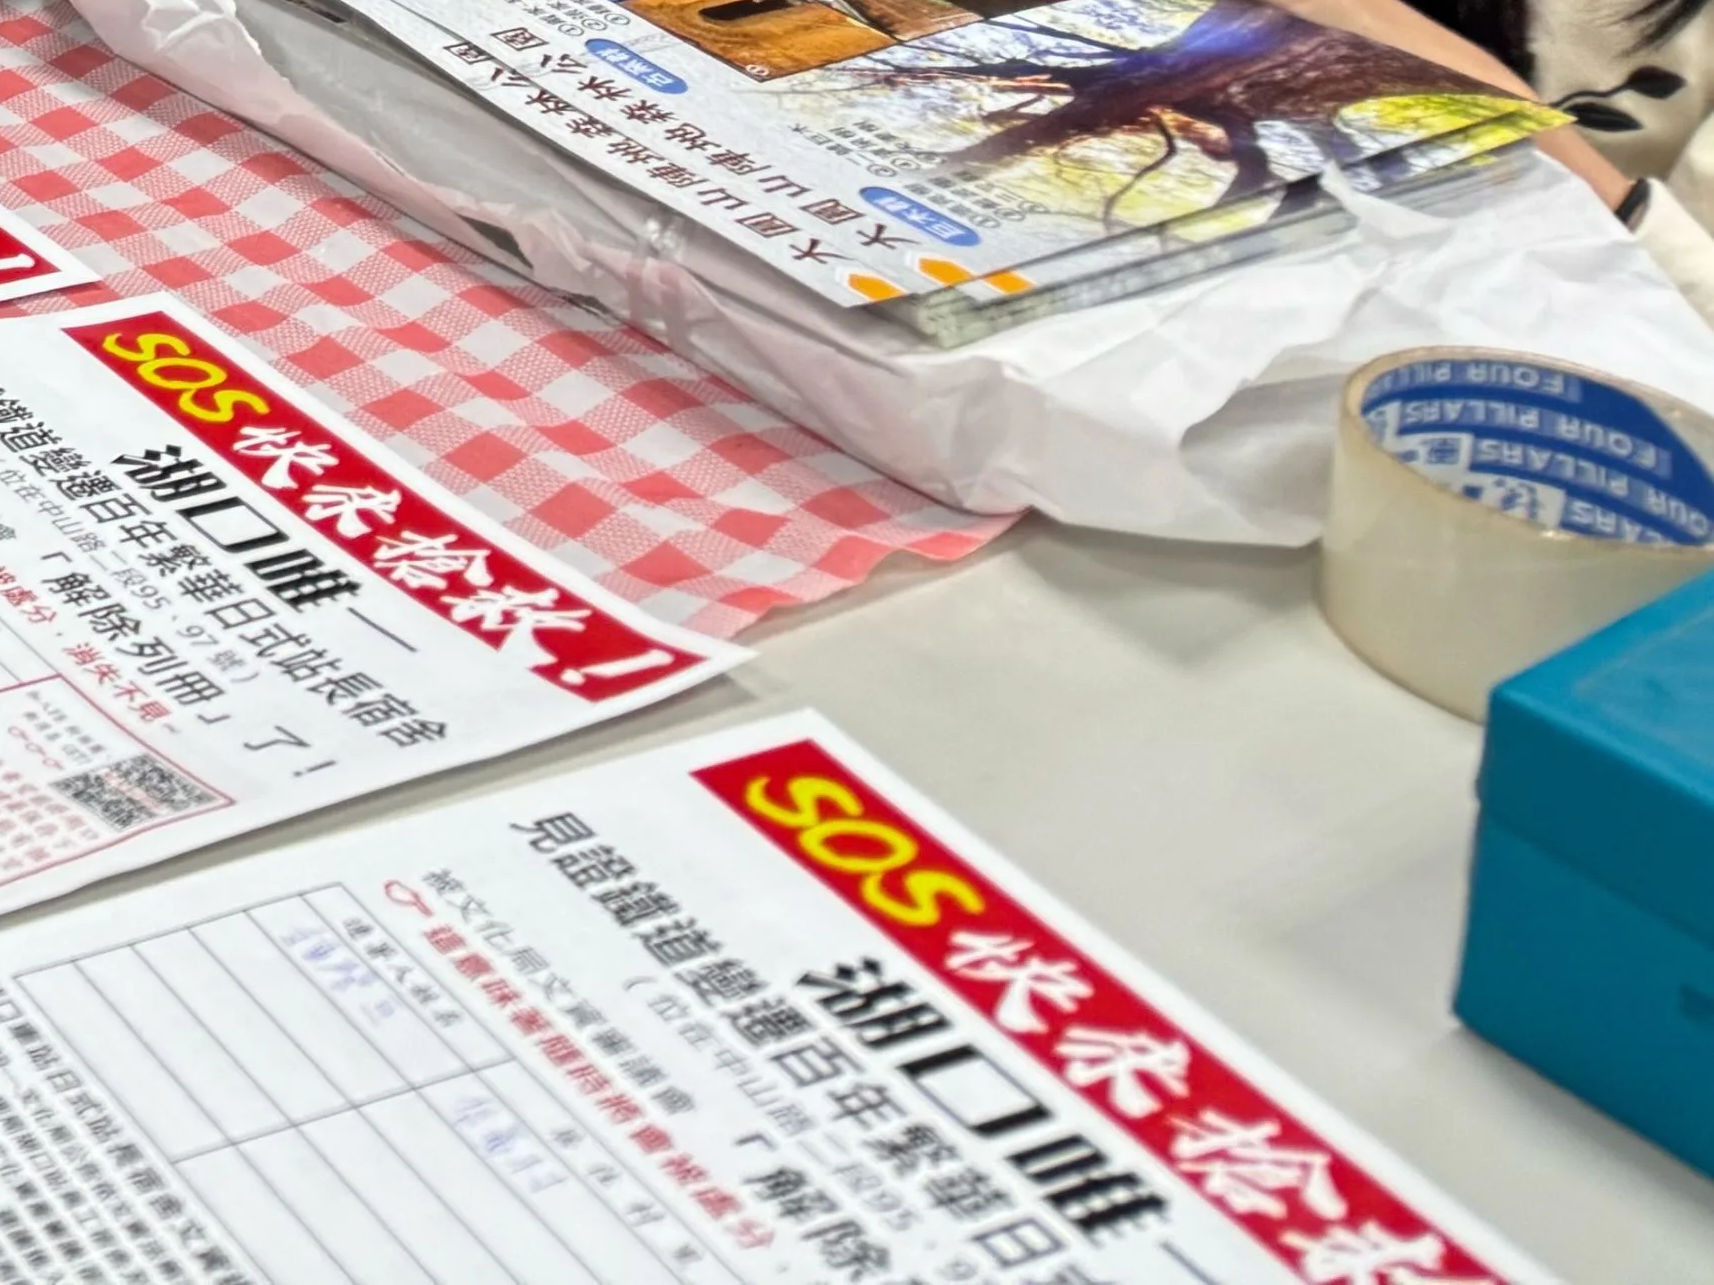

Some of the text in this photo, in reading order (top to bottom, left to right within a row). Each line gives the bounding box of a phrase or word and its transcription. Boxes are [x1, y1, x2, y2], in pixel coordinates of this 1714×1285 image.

[93, 328, 278, 424] SOS
[1405, 399, 1659, 468] FOUR PILLARS
[1466, 360, 1566, 395] FOUR
[1476, 439, 1630, 496] PILLARS
[105, 444, 421, 653] 湖口唯一
[39, 551, 231, 725] 「解除列冊」
[236, 725, 339, 779] 了!
[738, 770, 998, 929] SOS
[501, 811, 1094, 1284] 見證鐵道變遷百年繁華日
